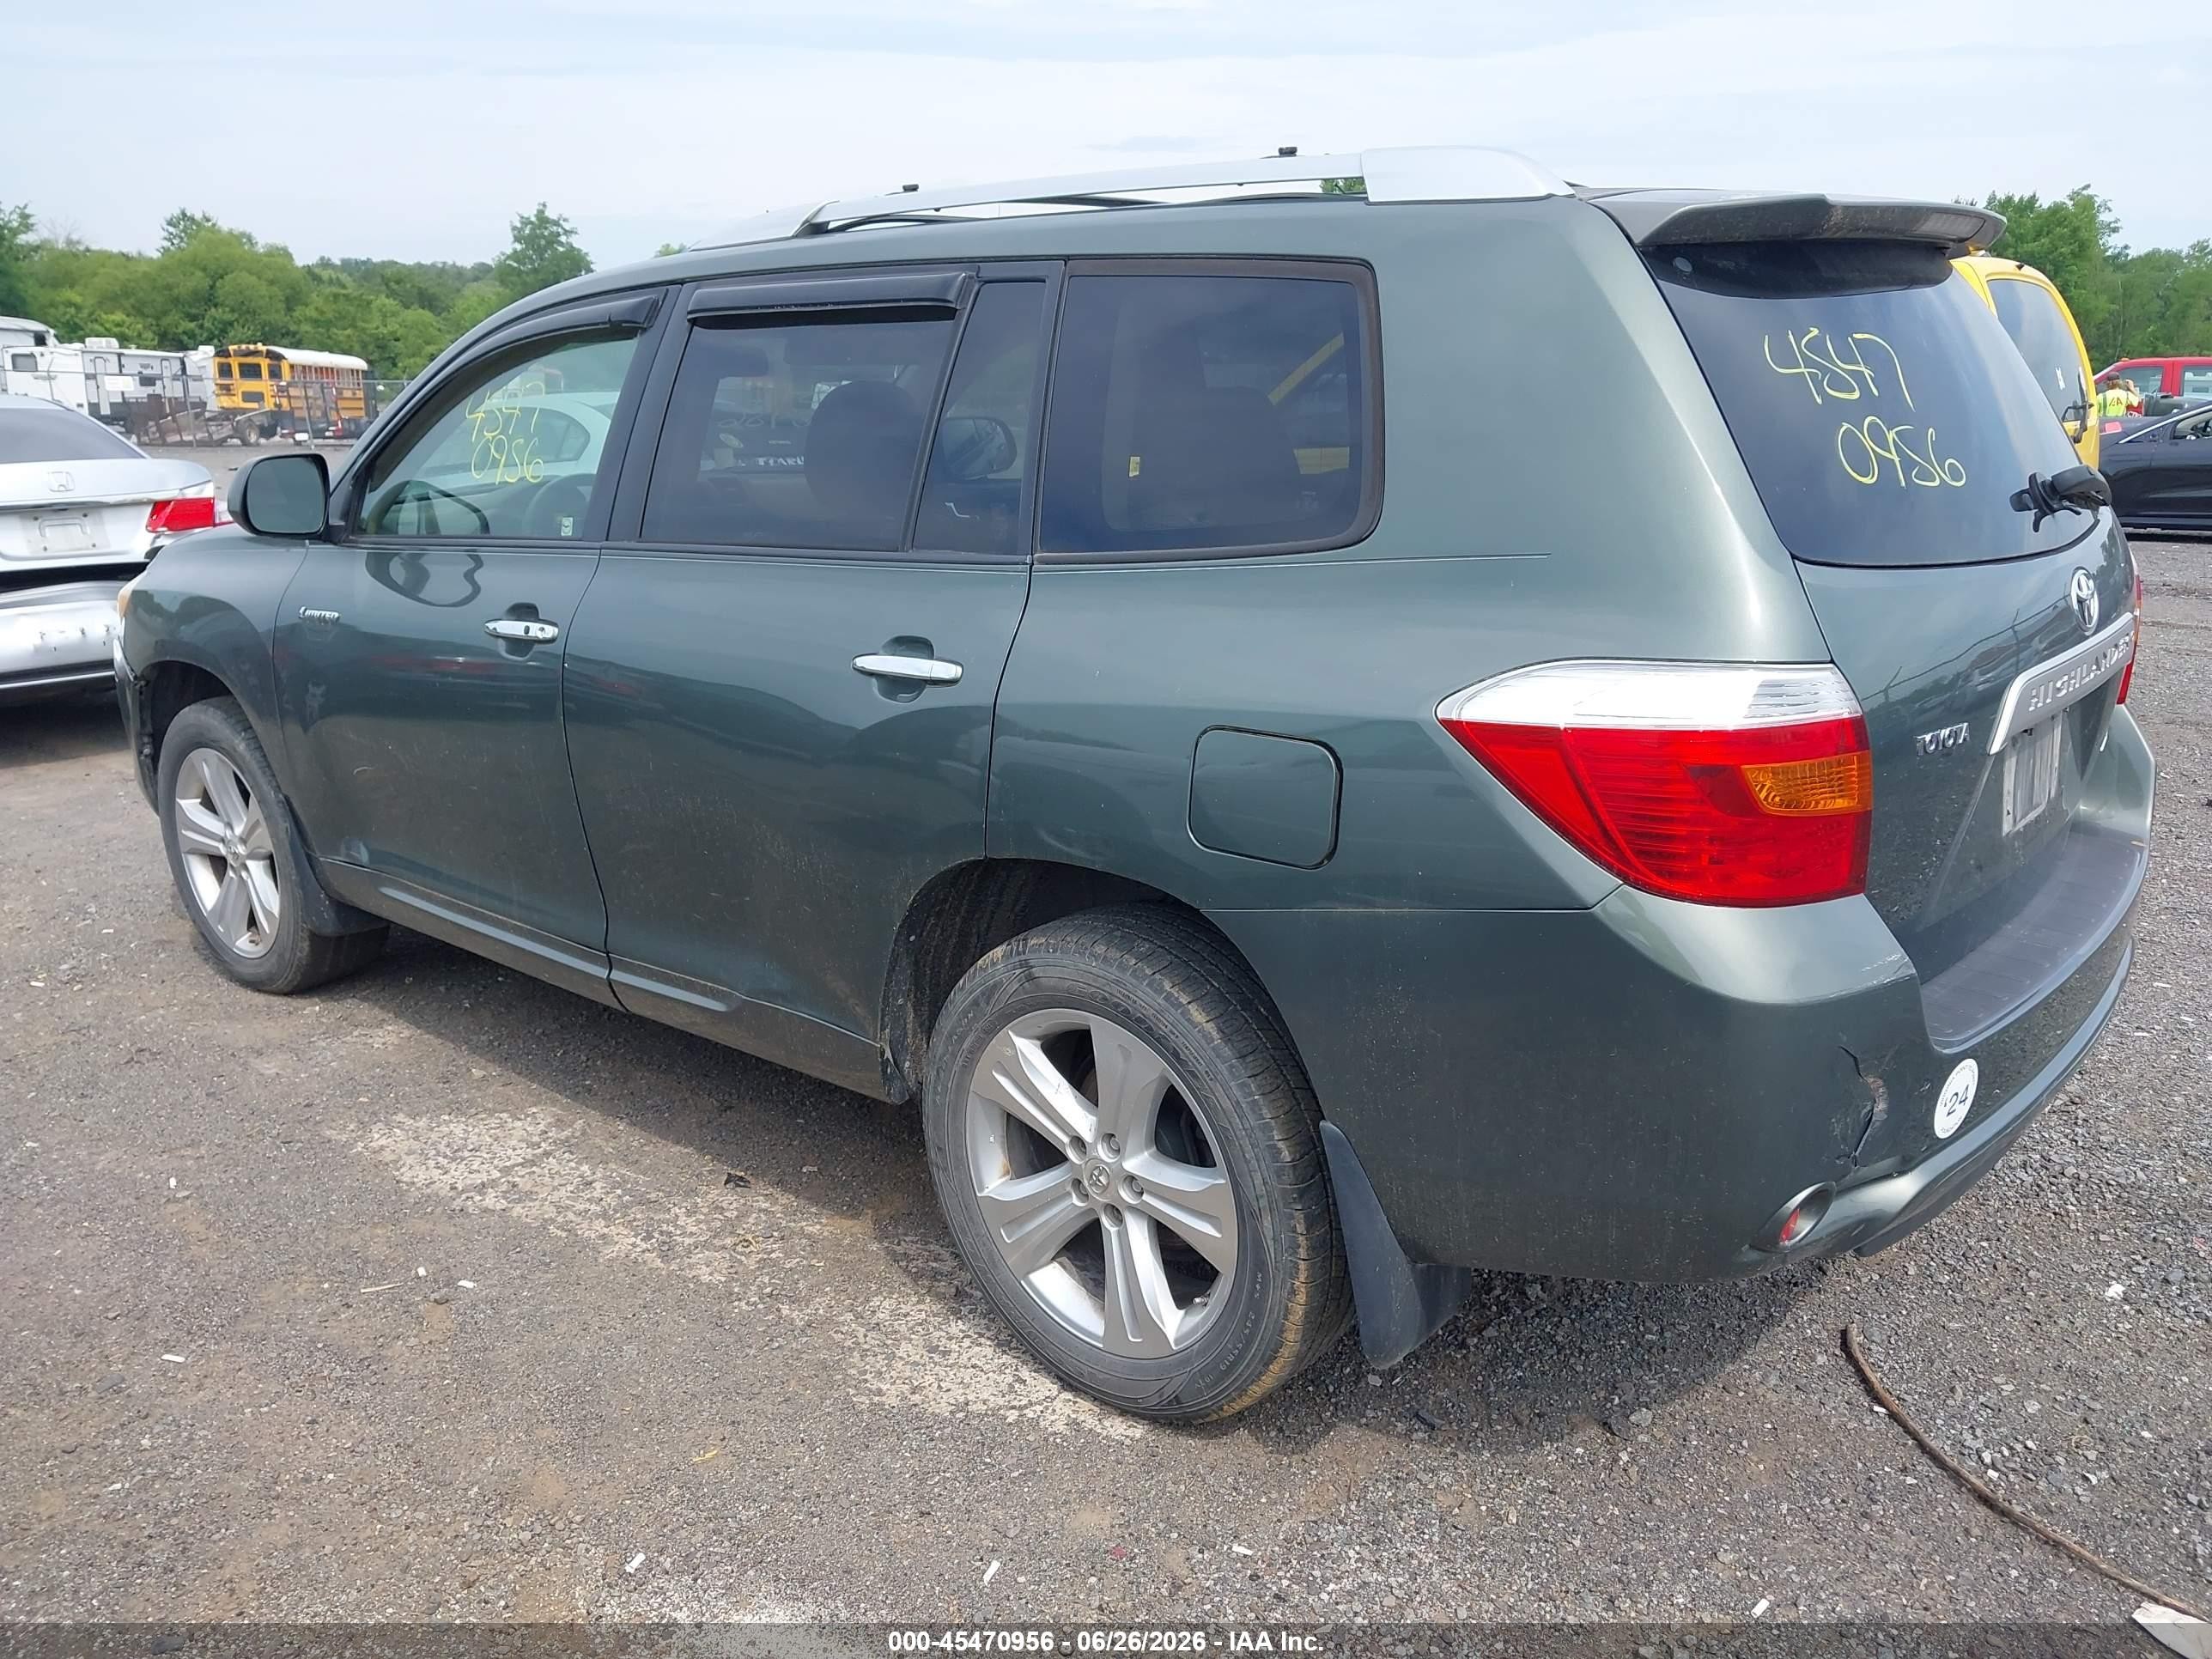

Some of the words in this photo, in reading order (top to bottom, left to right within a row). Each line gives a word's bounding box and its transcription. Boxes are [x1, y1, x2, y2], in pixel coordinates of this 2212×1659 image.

[1764, 327, 1916, 412] 4547
[471, 434, 544, 485] 0956
[1838, 416, 1966, 489] 0956
[2028, 632, 2131, 713] HIGHLANDER
[1914, 722, 1971, 757] TOYOTA
